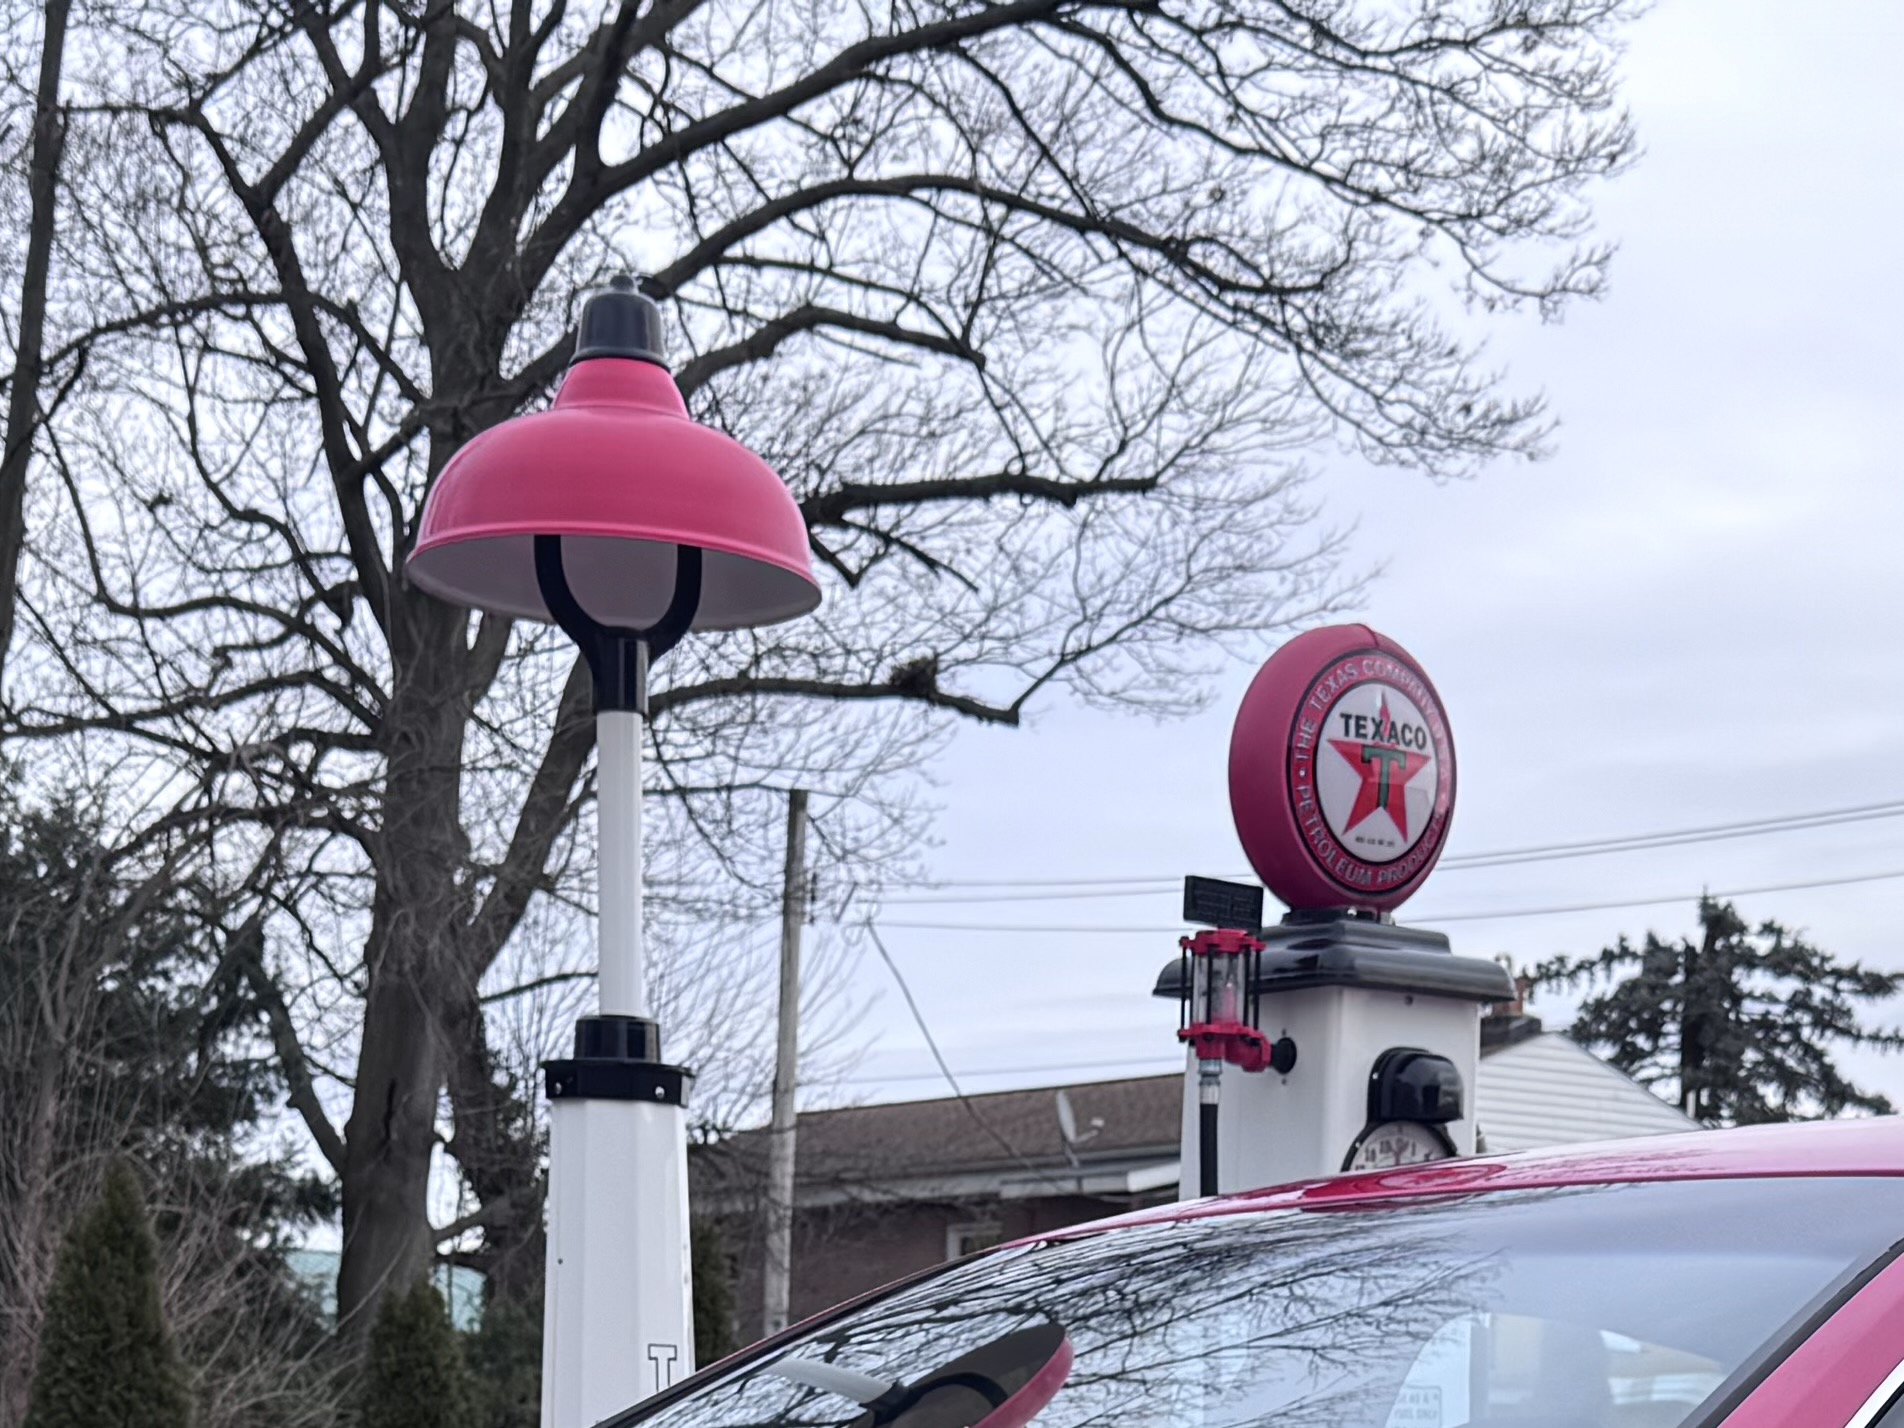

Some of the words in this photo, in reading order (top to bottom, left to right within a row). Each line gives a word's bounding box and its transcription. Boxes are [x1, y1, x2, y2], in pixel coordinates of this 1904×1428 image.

[1297, 718, 1316, 759] THE
[1310, 663, 1360, 710] TEXAS
[1339, 712, 1427, 750] TEXACO
[1361, 743, 1408, 808] T
[1296, 785, 1372, 886] PETROLEUM
